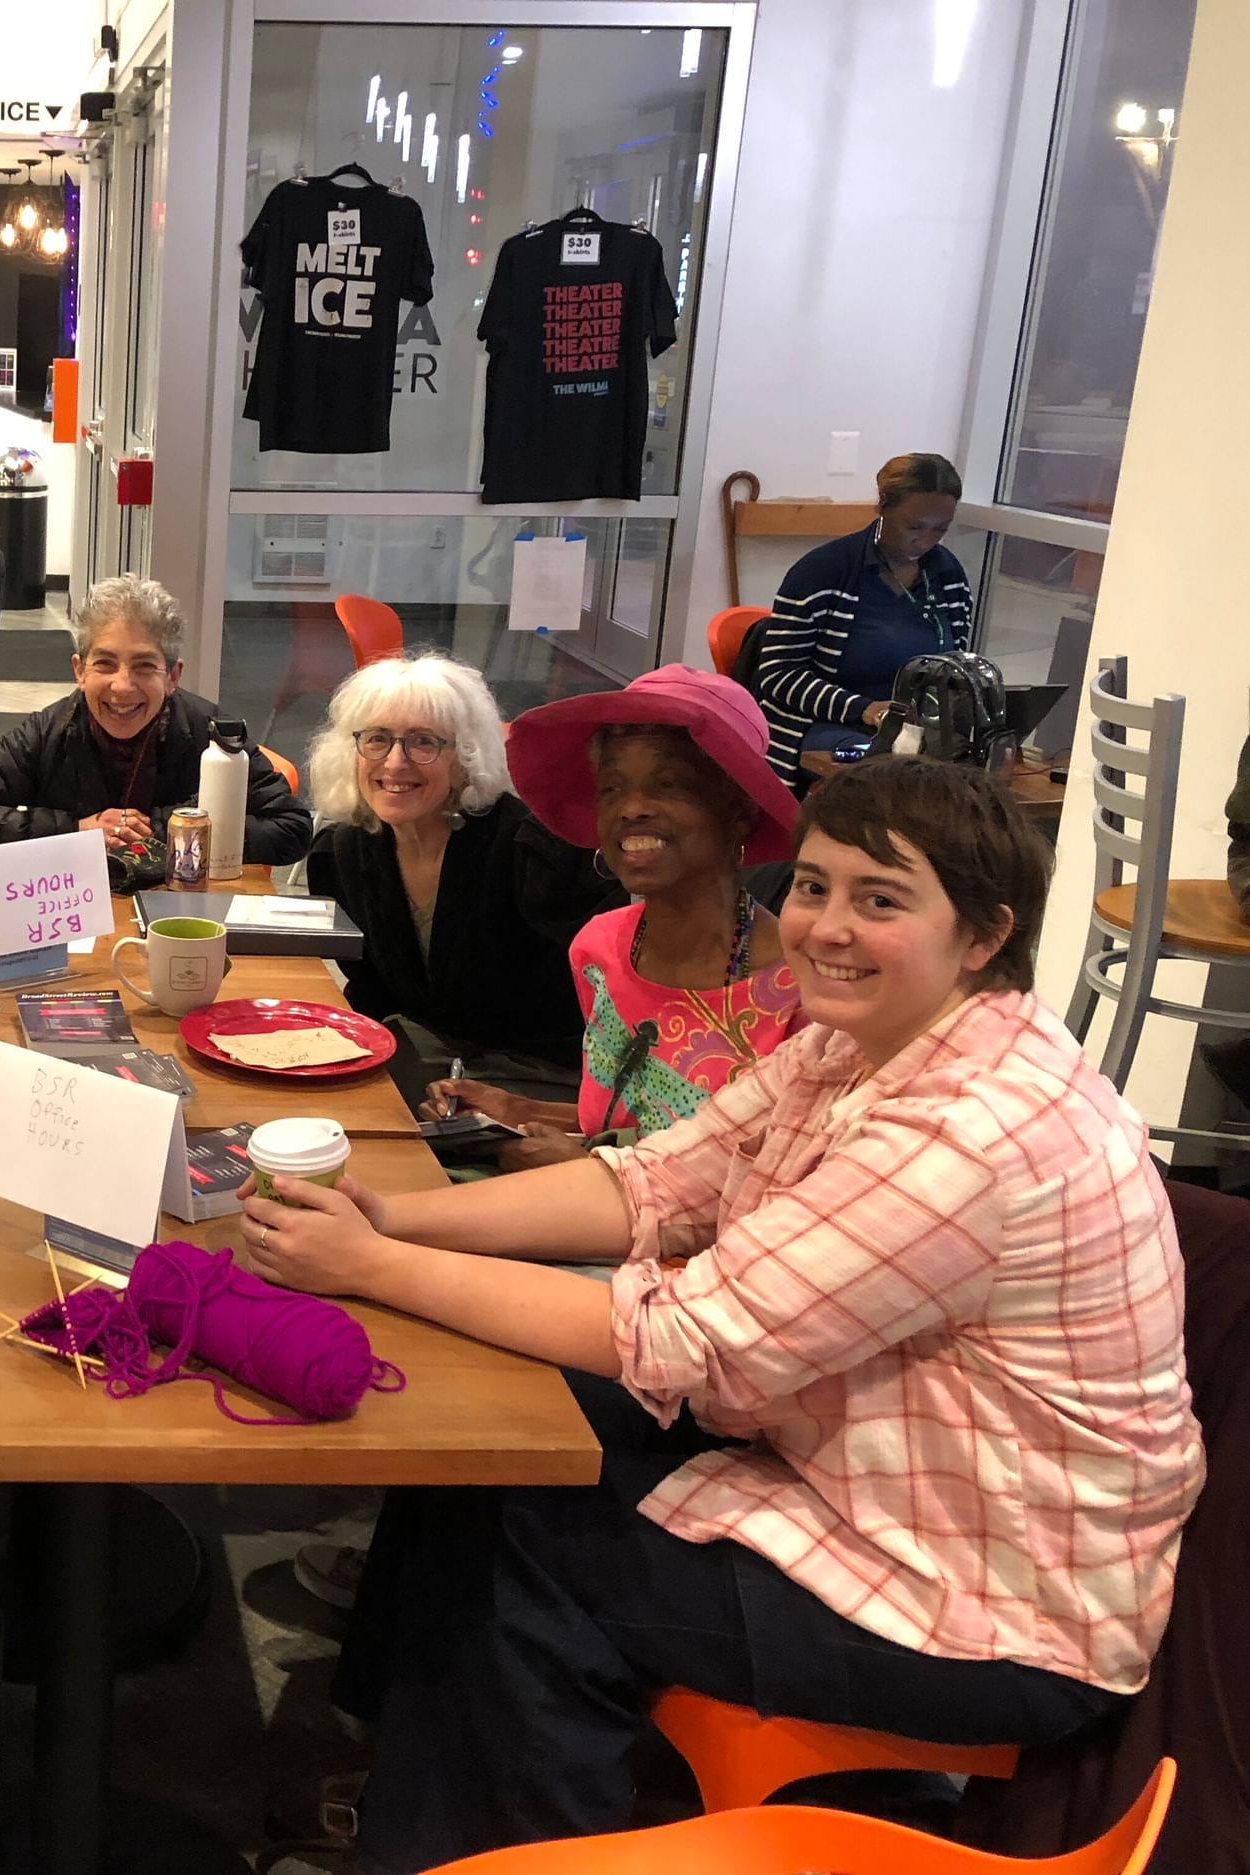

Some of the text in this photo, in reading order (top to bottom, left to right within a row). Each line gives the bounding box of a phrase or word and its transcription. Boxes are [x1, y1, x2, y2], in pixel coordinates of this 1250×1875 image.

[332, 220, 356, 231] $30
[568, 237, 592, 248] $30
[296, 243, 382, 276] MELT
[294, 277, 377, 328] ICE
[543, 282, 623, 303] THEATER
[543, 300, 622, 321] THEATER
[543, 318, 621, 339] THEATER
[543, 335, 620, 356] THEATRE
[543, 352, 619, 374] THEATER
[553, 384, 575, 395] THE
[5, 872, 75, 901] HOURS
[38, 888, 94, 915] OFFICE
[27, 914, 82, 943] BSR
[32, 1068, 77, 1104] BSR
[27, 1122, 84, 1156] HOURS
